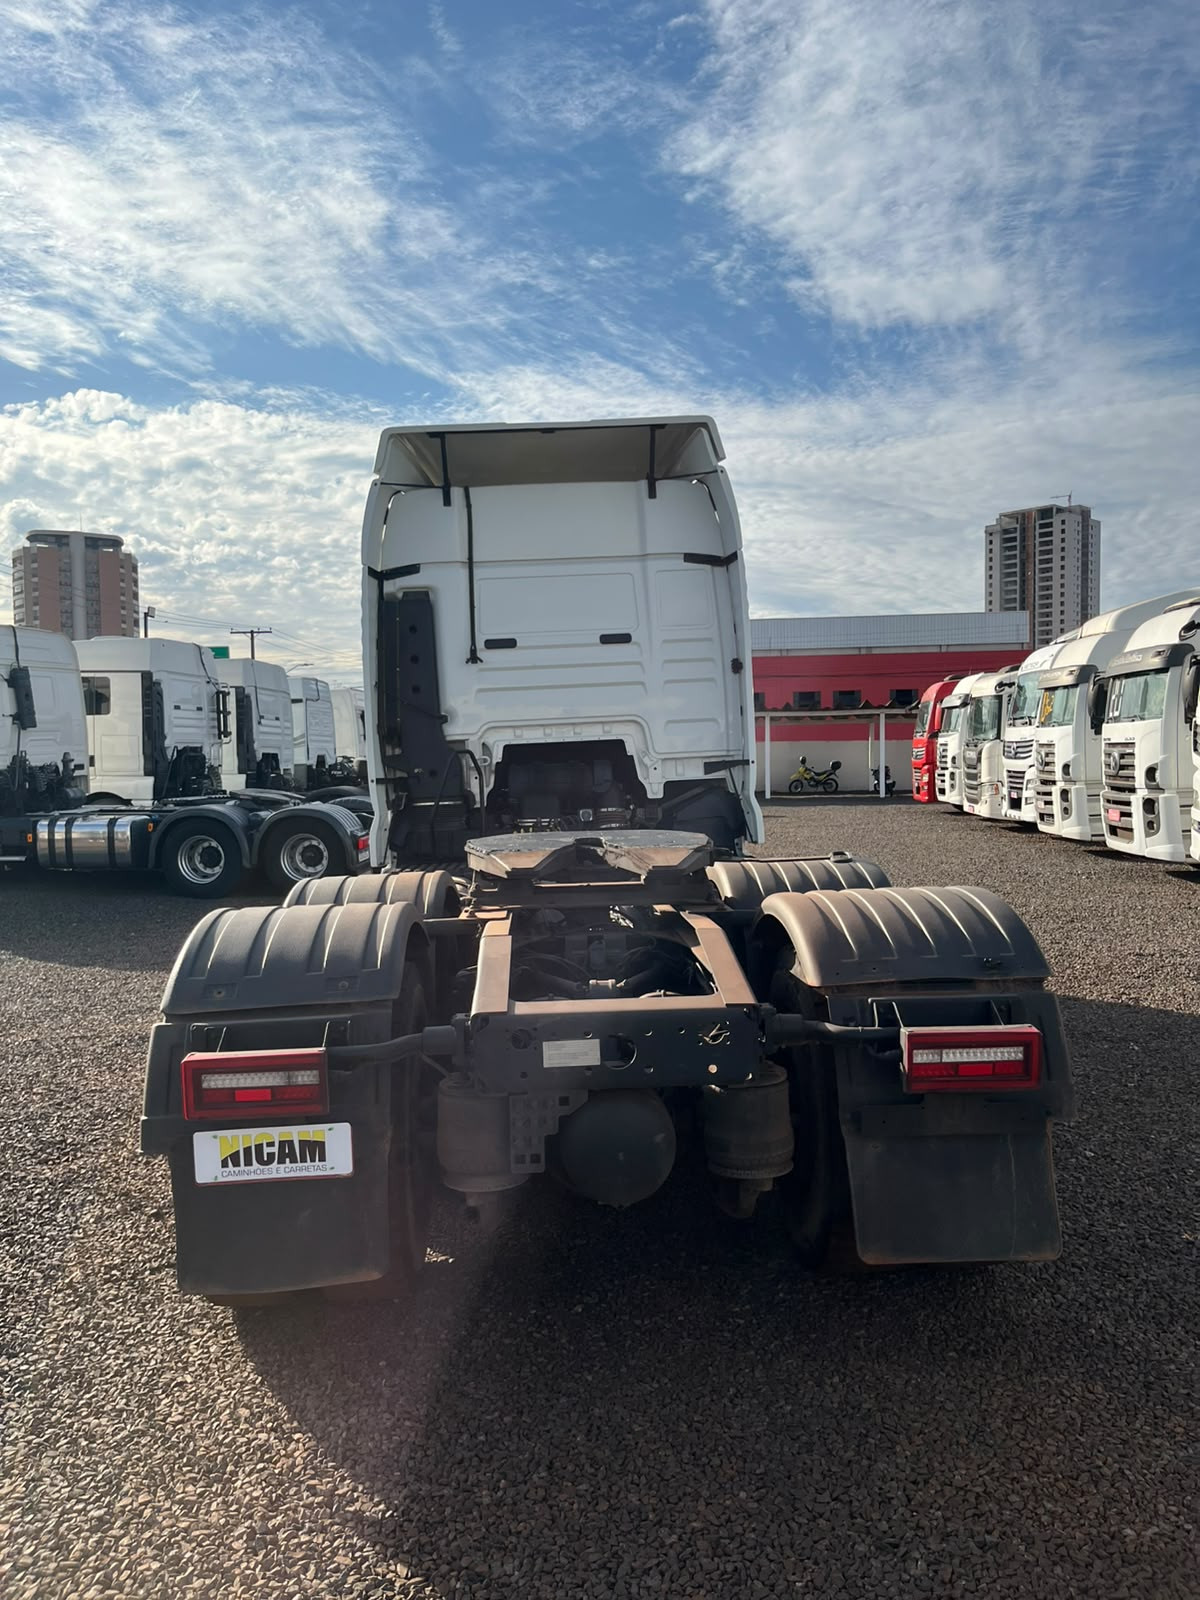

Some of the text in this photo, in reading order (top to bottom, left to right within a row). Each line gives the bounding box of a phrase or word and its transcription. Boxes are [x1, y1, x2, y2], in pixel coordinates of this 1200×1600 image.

[219, 1130, 327, 1168] NICAM
[221, 1164, 327, 1178] CAMINHÕES E CARRETAS
